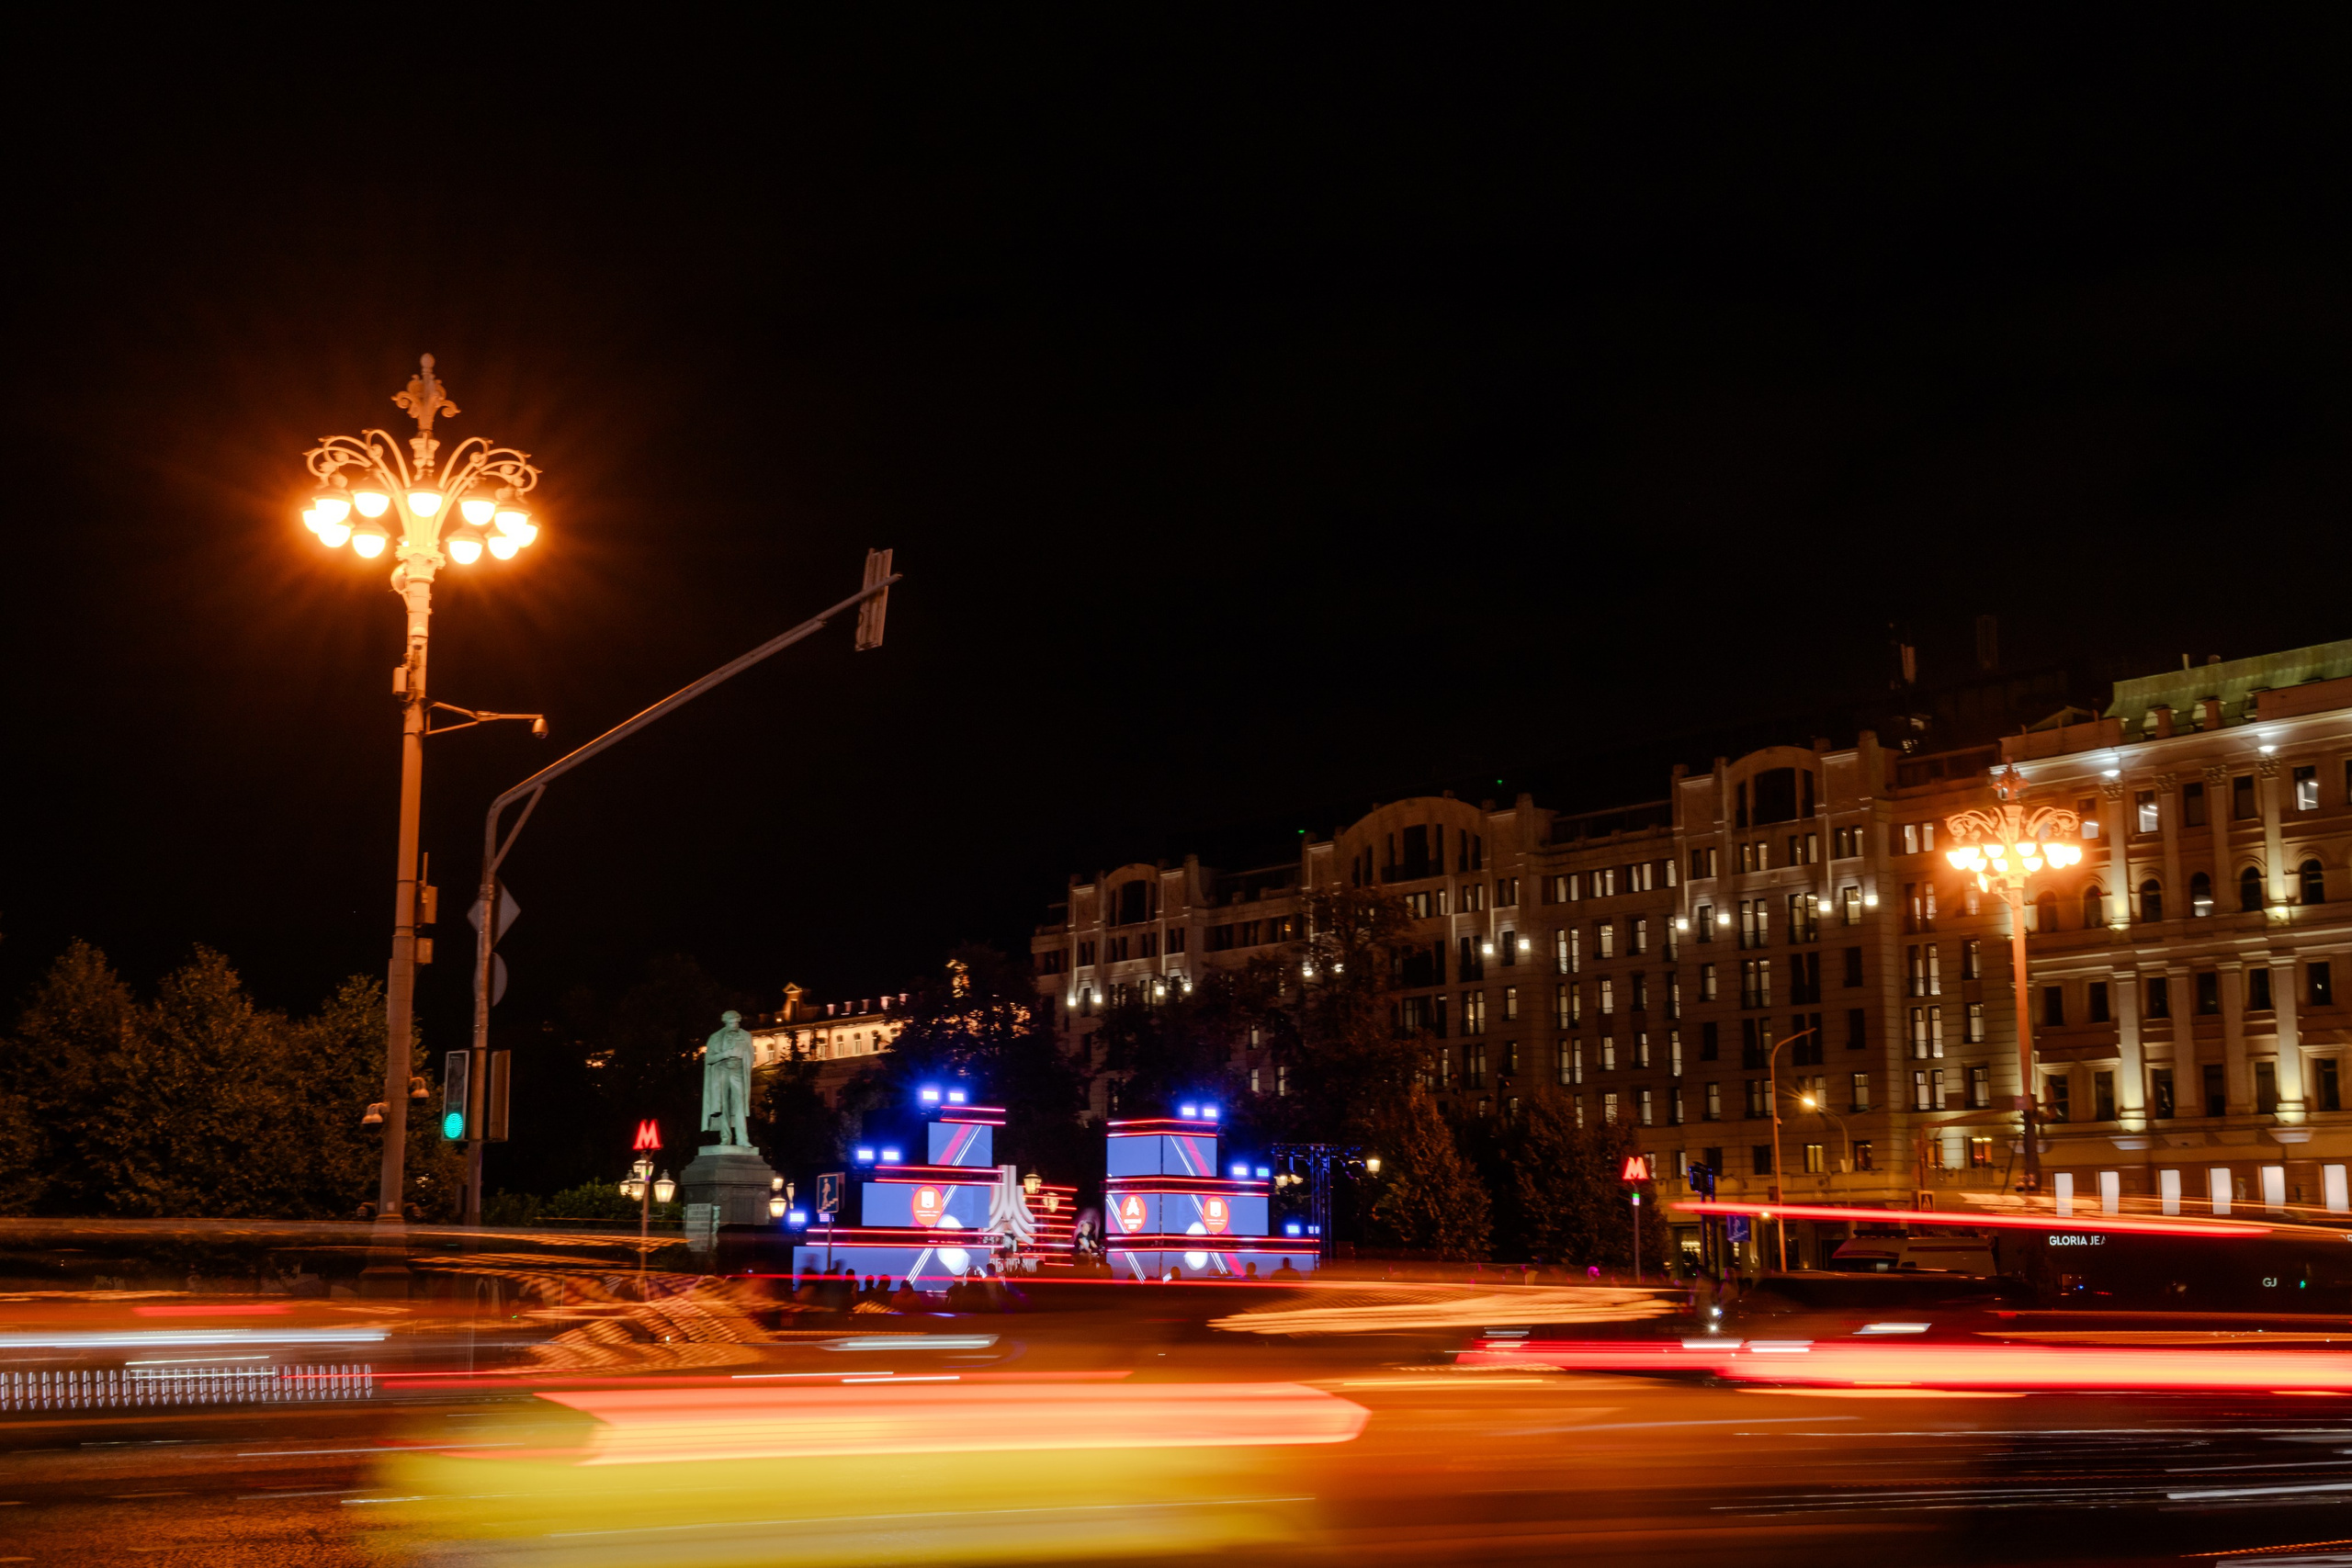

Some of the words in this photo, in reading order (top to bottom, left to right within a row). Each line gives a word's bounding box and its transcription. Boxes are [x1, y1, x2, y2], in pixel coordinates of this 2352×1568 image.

[2049, 1235, 2088, 1247] GLORIA
[2089, 1235, 2110, 1246] JEA
[2262, 1277, 2278, 1288] GJ
